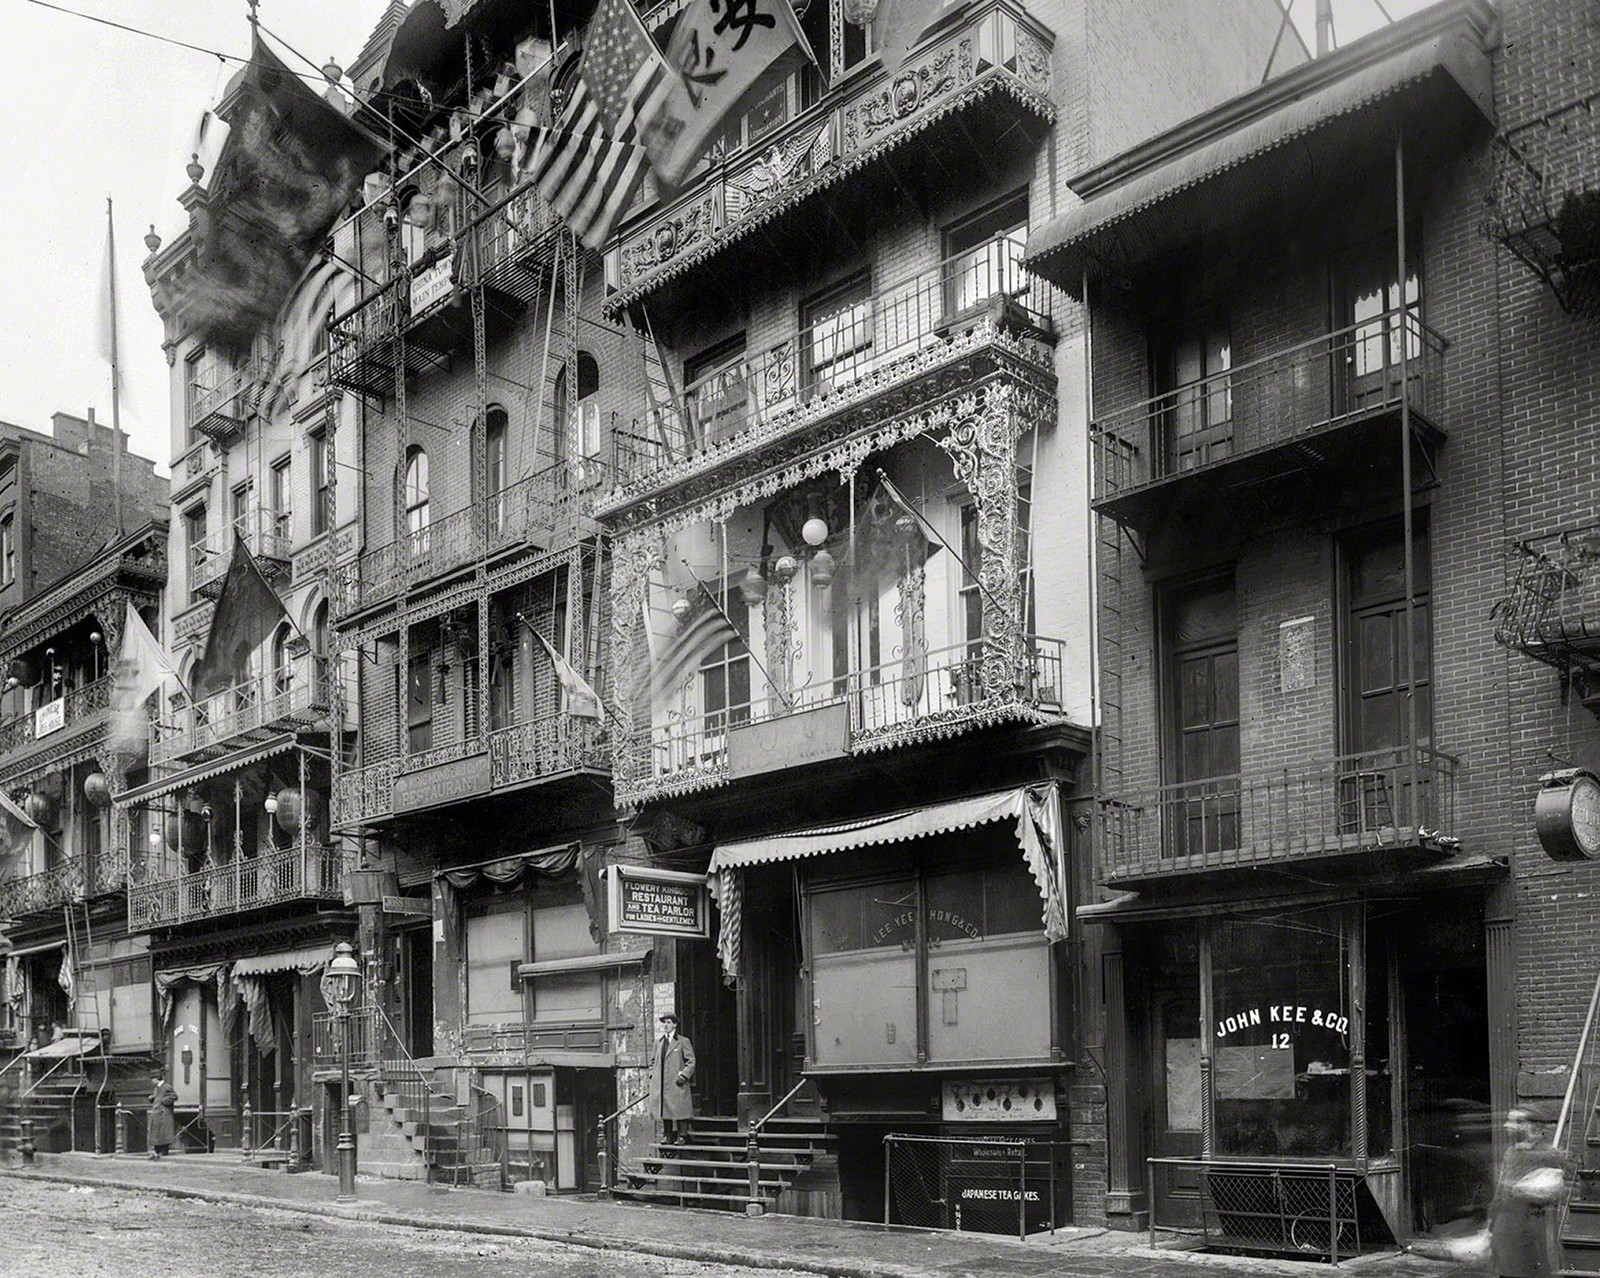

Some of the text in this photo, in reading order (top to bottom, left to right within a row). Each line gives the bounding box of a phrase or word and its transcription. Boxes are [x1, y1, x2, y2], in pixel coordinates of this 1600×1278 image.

[402, 776, 480, 806] RESTAURANT
[625, 882, 660, 893] FLOWERY
[632, 891, 688, 906] RESTAURANT
[627, 903, 695, 917] AND TEA PARLOR
[636, 913, 657, 922] LADIES
[662, 915, 695, 925] GENTLEMEN
[873, 923, 893, 944] LEE
[894, 911, 914, 927] YEE
[1216, 1008, 1261, 1038] JOHN
[1270, 1005, 1307, 1023] KEE
[1271, 1033, 1290, 1049] 12
[961, 1189, 998, 1200] JAPANESE
[998, 1190, 1013, 1200] TEA
